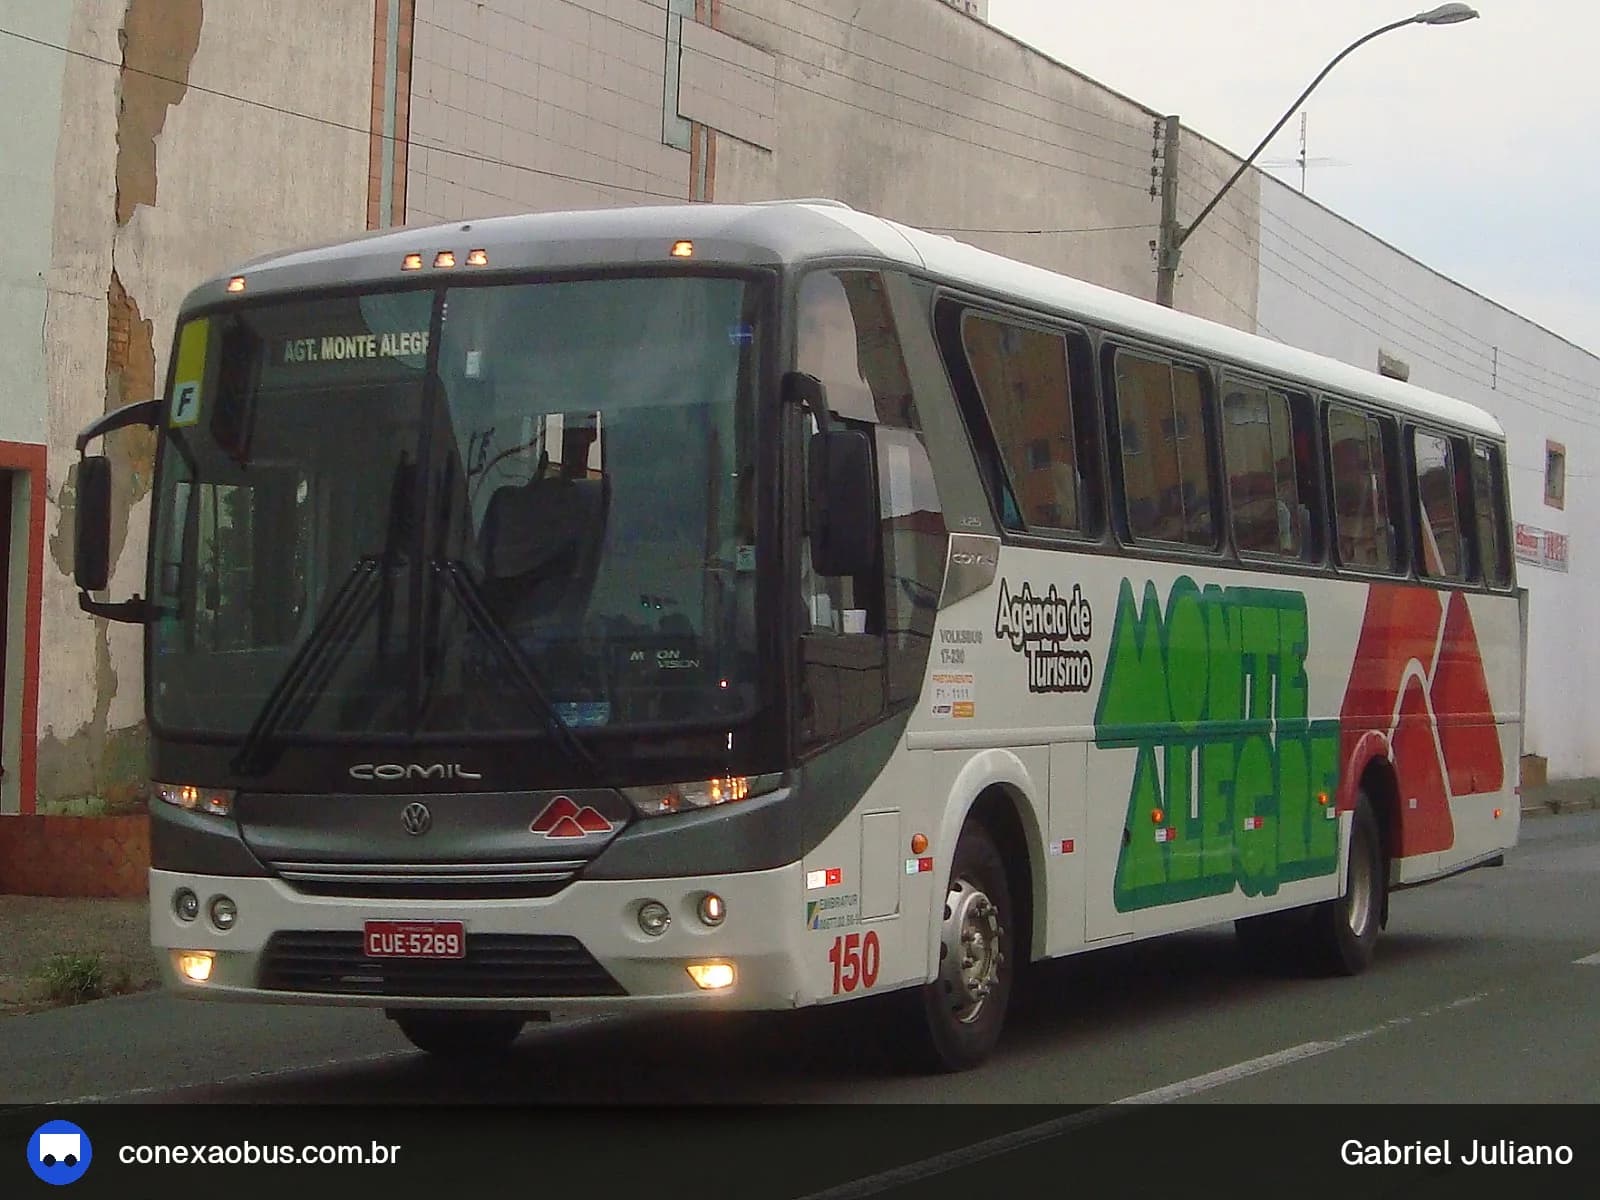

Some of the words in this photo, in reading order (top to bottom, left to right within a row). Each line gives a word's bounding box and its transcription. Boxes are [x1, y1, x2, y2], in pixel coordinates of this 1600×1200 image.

[321, 335, 377, 360] MONTE
[177, 387, 193, 416] F
[996, 577, 1068, 652] Agência
[1070, 583, 1092, 641] de
[1024, 640, 1093, 693] Turismo
[1094, 575, 1310, 746] MONTE
[349, 763, 483, 780] COMIL
[1113, 722, 1340, 913] ALEGRE
[829, 930, 880, 995] 150
